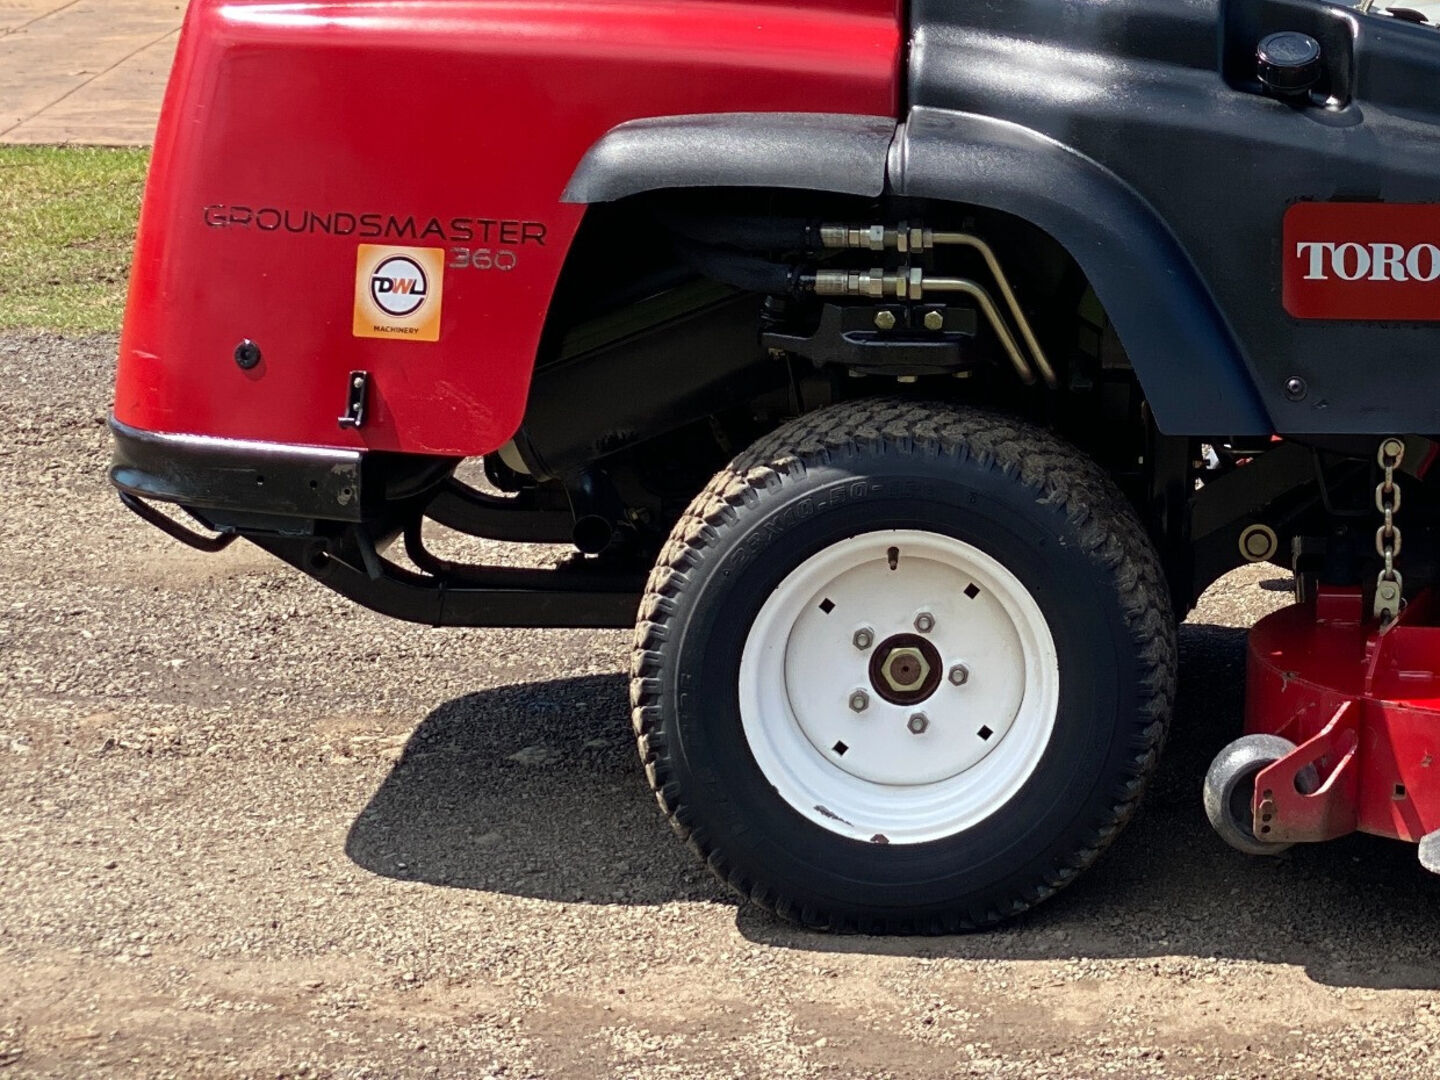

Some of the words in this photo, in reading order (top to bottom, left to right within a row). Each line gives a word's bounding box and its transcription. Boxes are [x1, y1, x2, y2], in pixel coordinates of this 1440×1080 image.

[204, 204, 547, 246] GROUNDSMASTER
[449, 247, 517, 271] 360
[371, 276, 427, 296] DWL
[373, 324, 420, 335] MACHINERY
